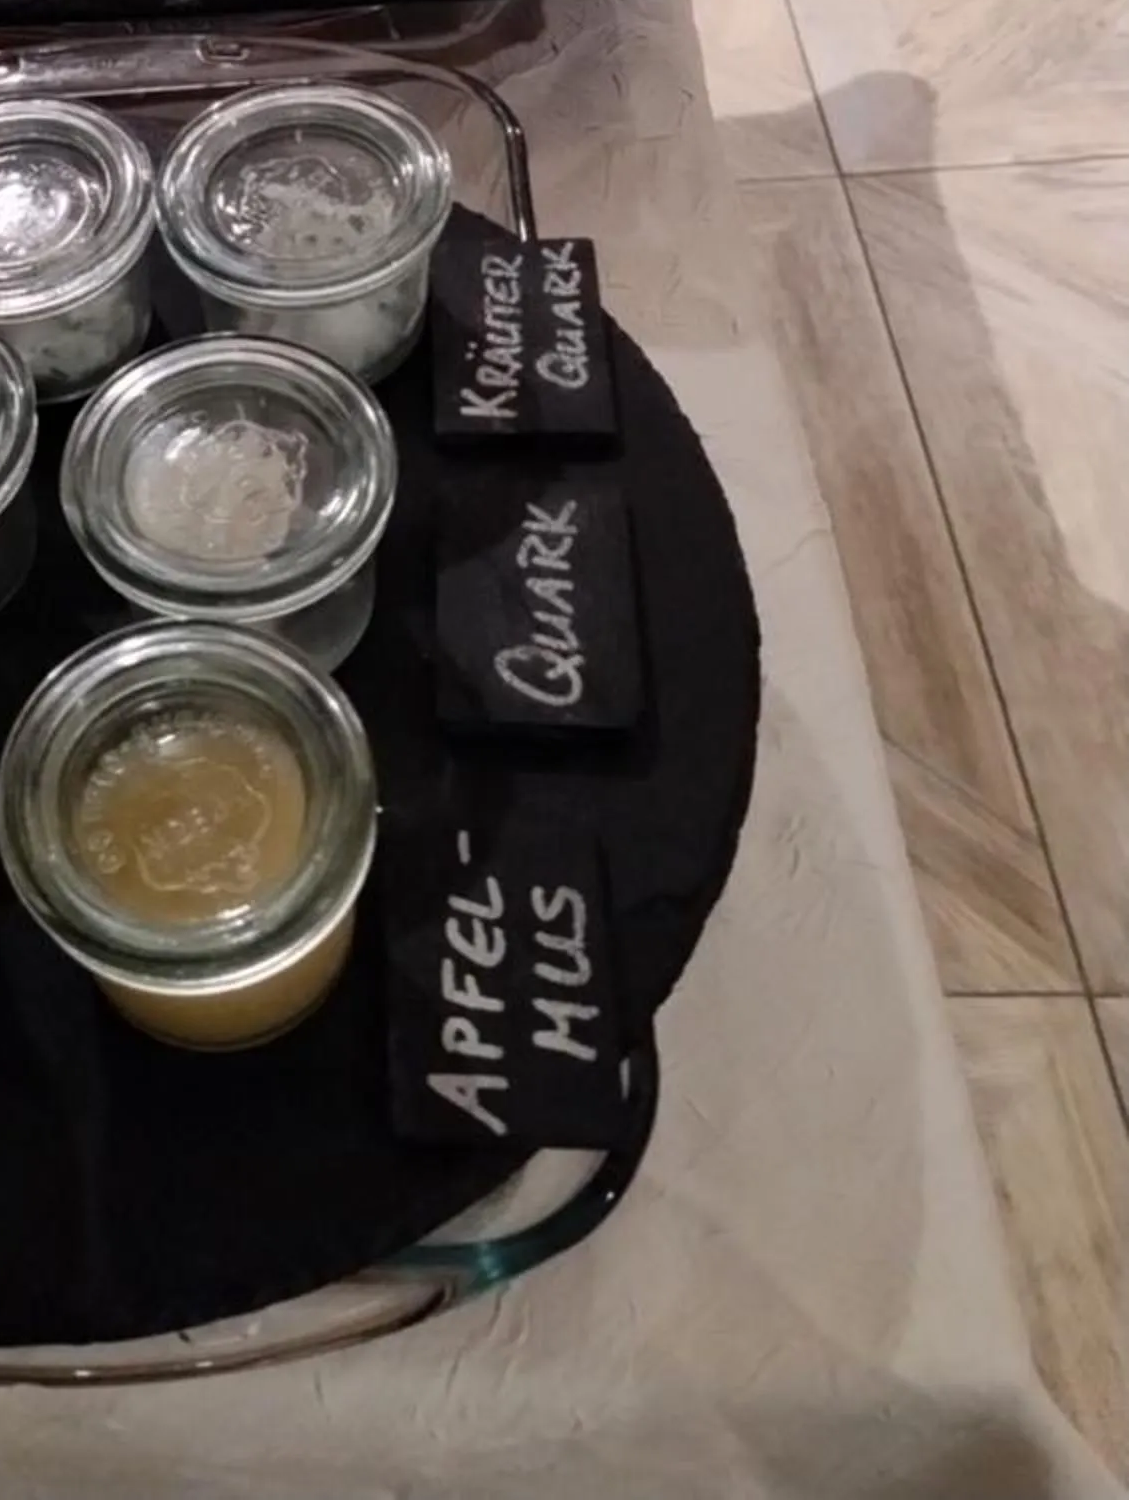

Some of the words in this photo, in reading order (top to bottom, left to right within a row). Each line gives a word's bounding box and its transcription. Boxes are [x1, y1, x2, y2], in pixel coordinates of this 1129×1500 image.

[459, 253, 523, 418] KRÄUTER
[535, 241, 589, 389] QUARK
[494, 501, 579, 706] QUARK
[427, 830, 510, 1136] APFEL-
[531, 885, 598, 1062] MUS
